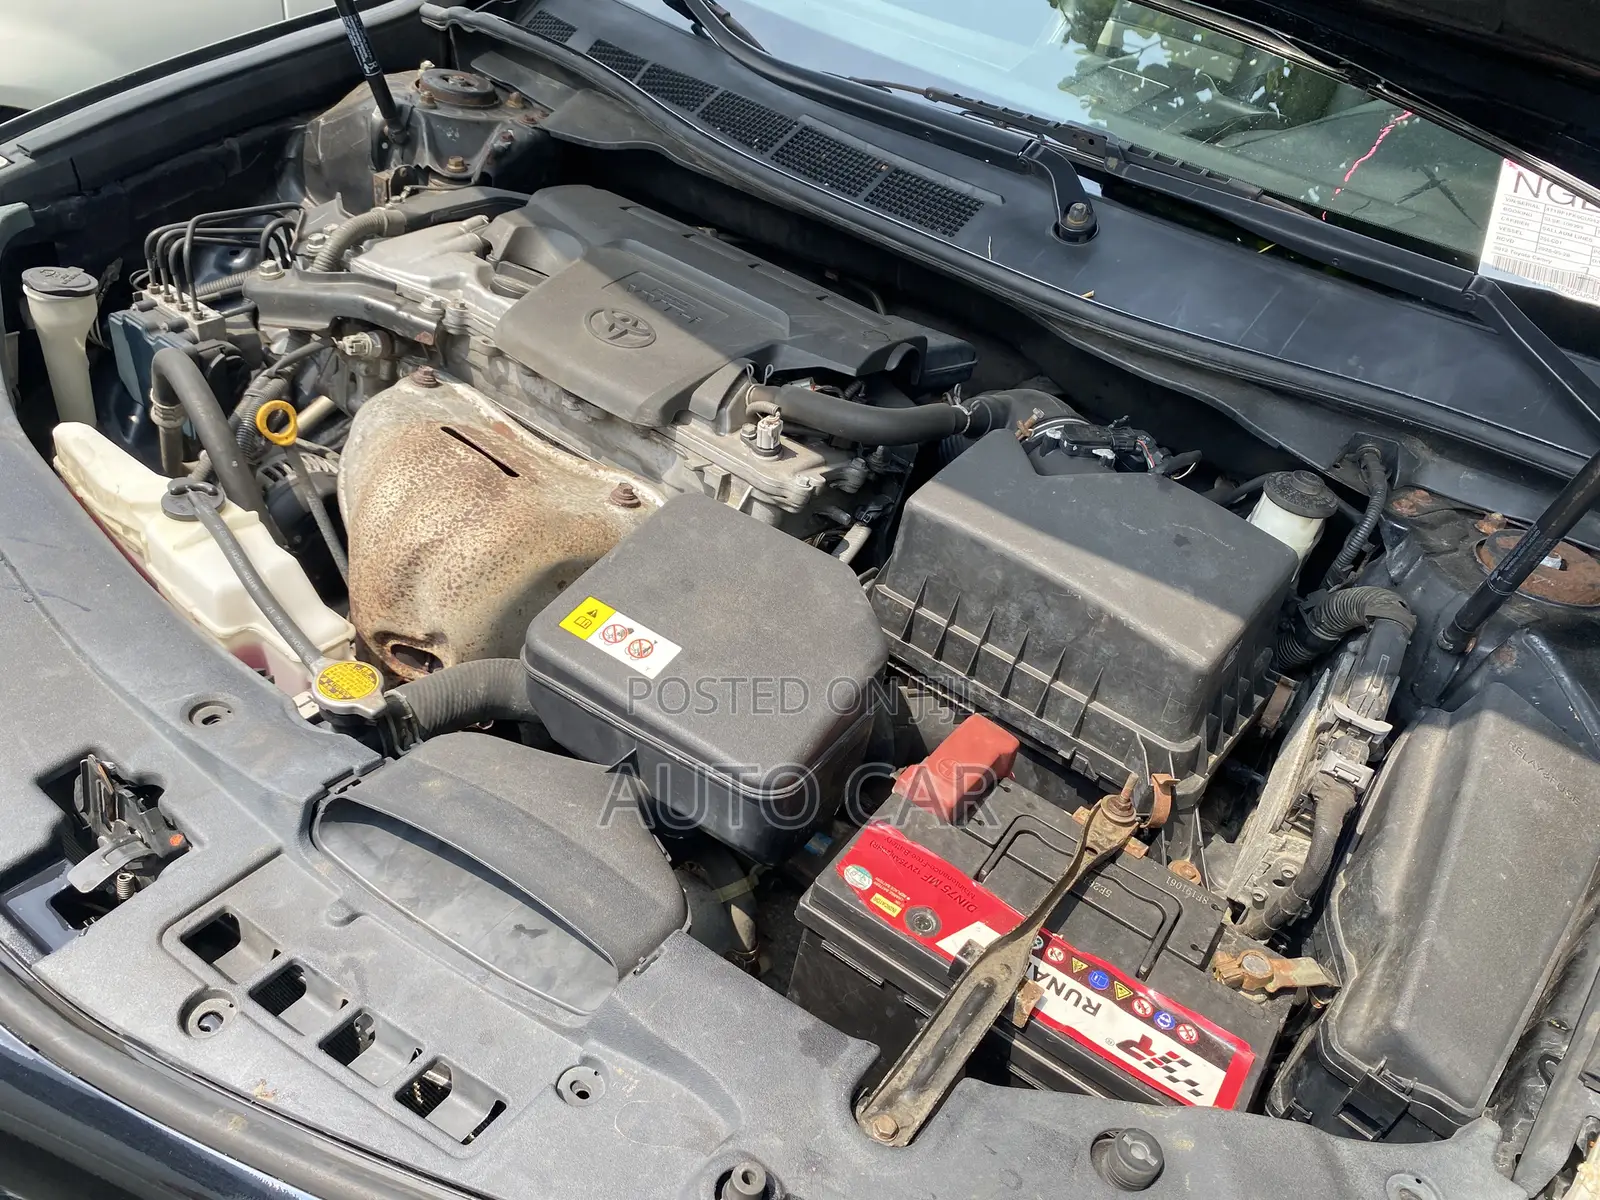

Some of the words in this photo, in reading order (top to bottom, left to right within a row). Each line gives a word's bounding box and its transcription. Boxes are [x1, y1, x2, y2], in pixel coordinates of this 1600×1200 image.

[1511, 249, 1530, 258] Toyota
[920, 874, 942, 888] MF
[940, 885, 978, 913] DIN75
[1027, 961, 1102, 1017] RUNA
